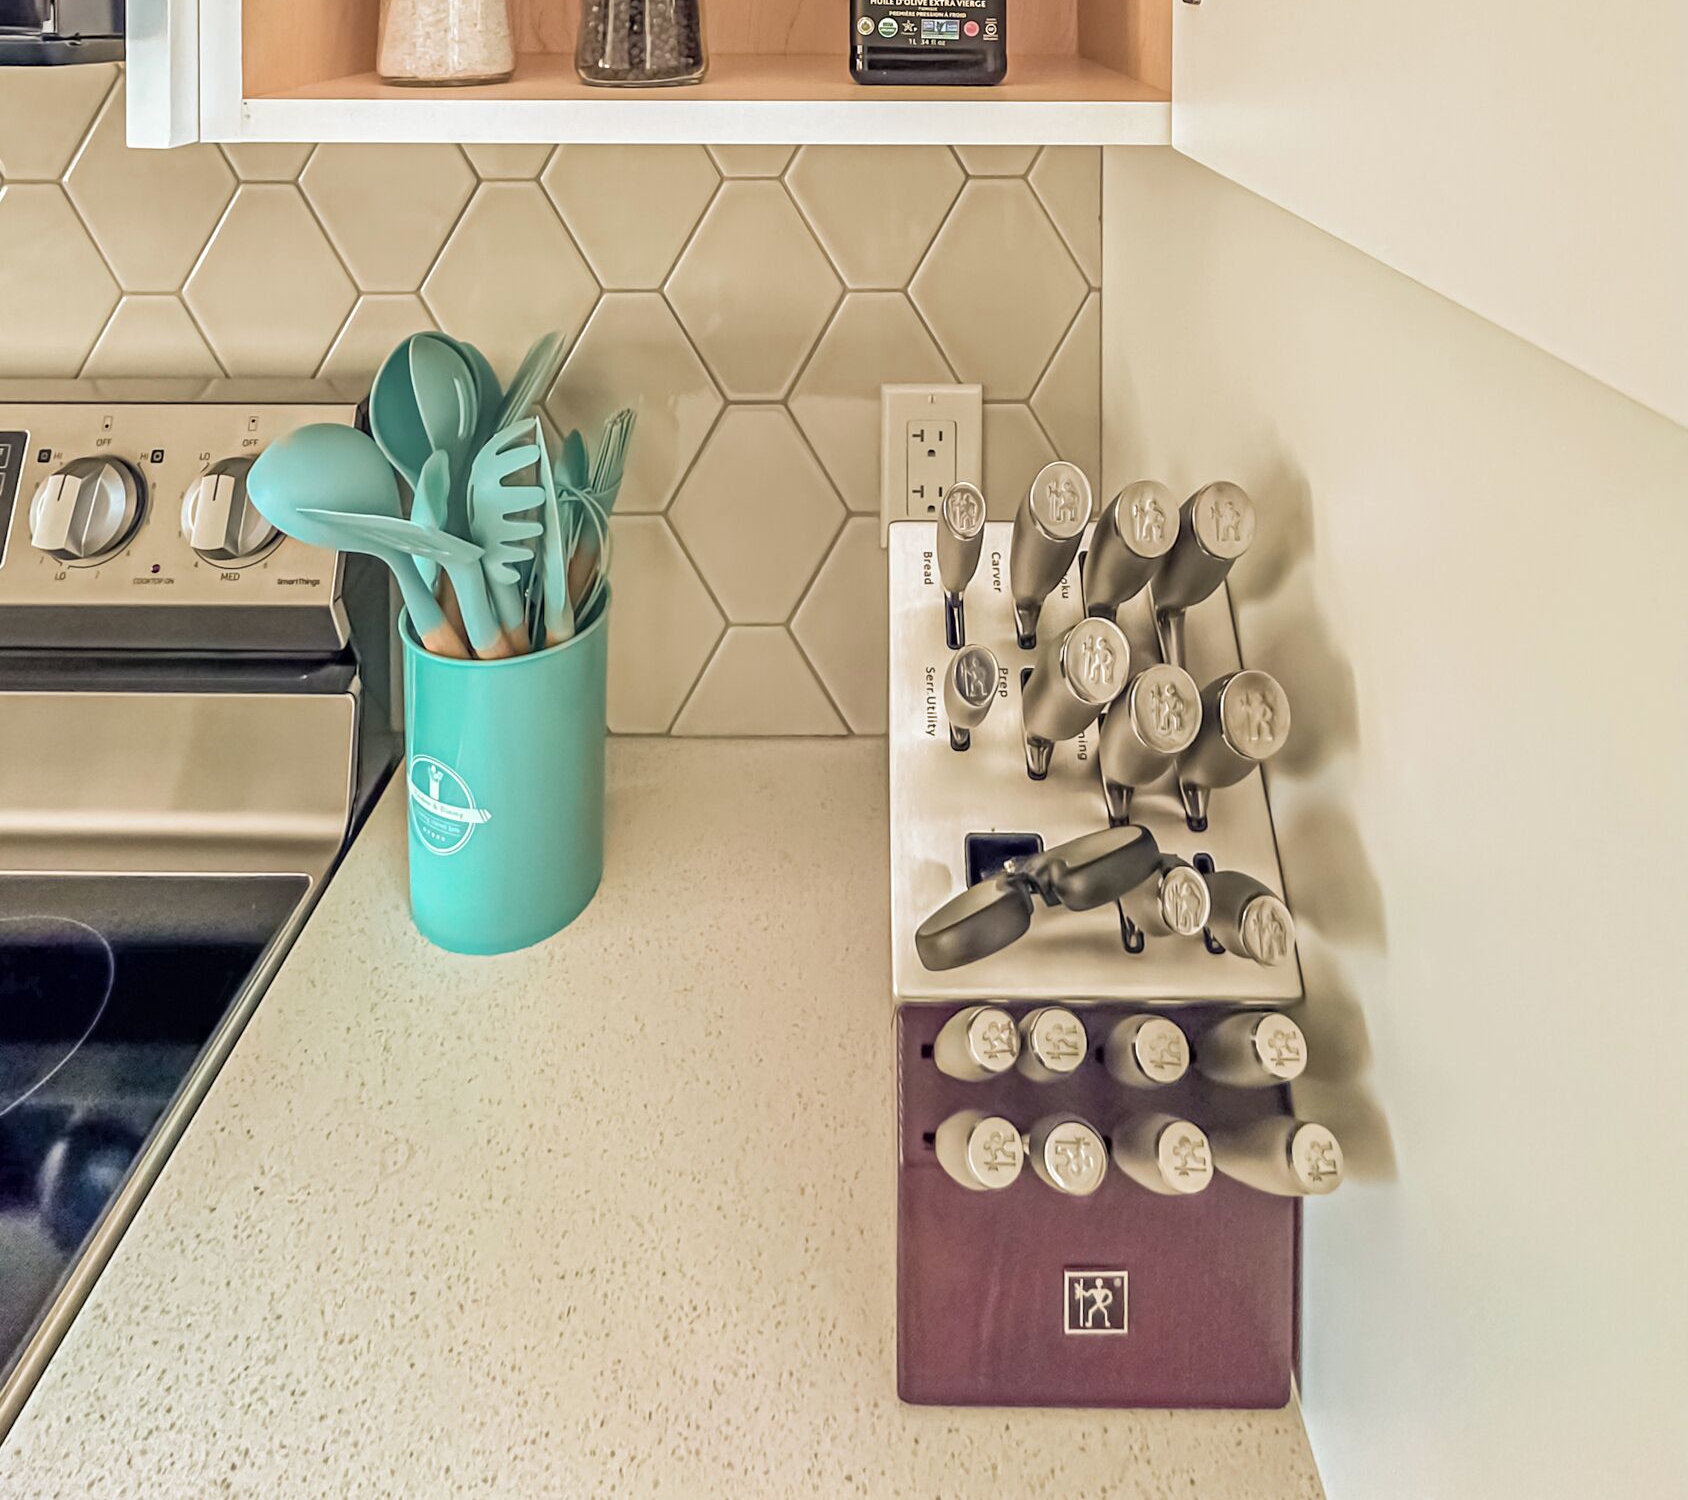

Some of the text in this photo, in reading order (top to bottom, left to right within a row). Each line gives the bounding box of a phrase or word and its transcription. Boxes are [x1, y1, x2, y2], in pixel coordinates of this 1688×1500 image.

[929, 0, 956, 7] EXTRA
[956, 0, 987, 8] VIERGE
[96, 438, 112, 447] OFF
[242, 438, 259, 447] OFF
[199, 452, 211, 461] LO
[923, 551, 934, 585] Bread
[991, 551, 1002, 592] Carver
[54, 571, 66, 581] LO
[220, 572, 241, 581] MED
[277, 578, 320, 587] SmartThings
[998, 667, 1009, 698] Prep
